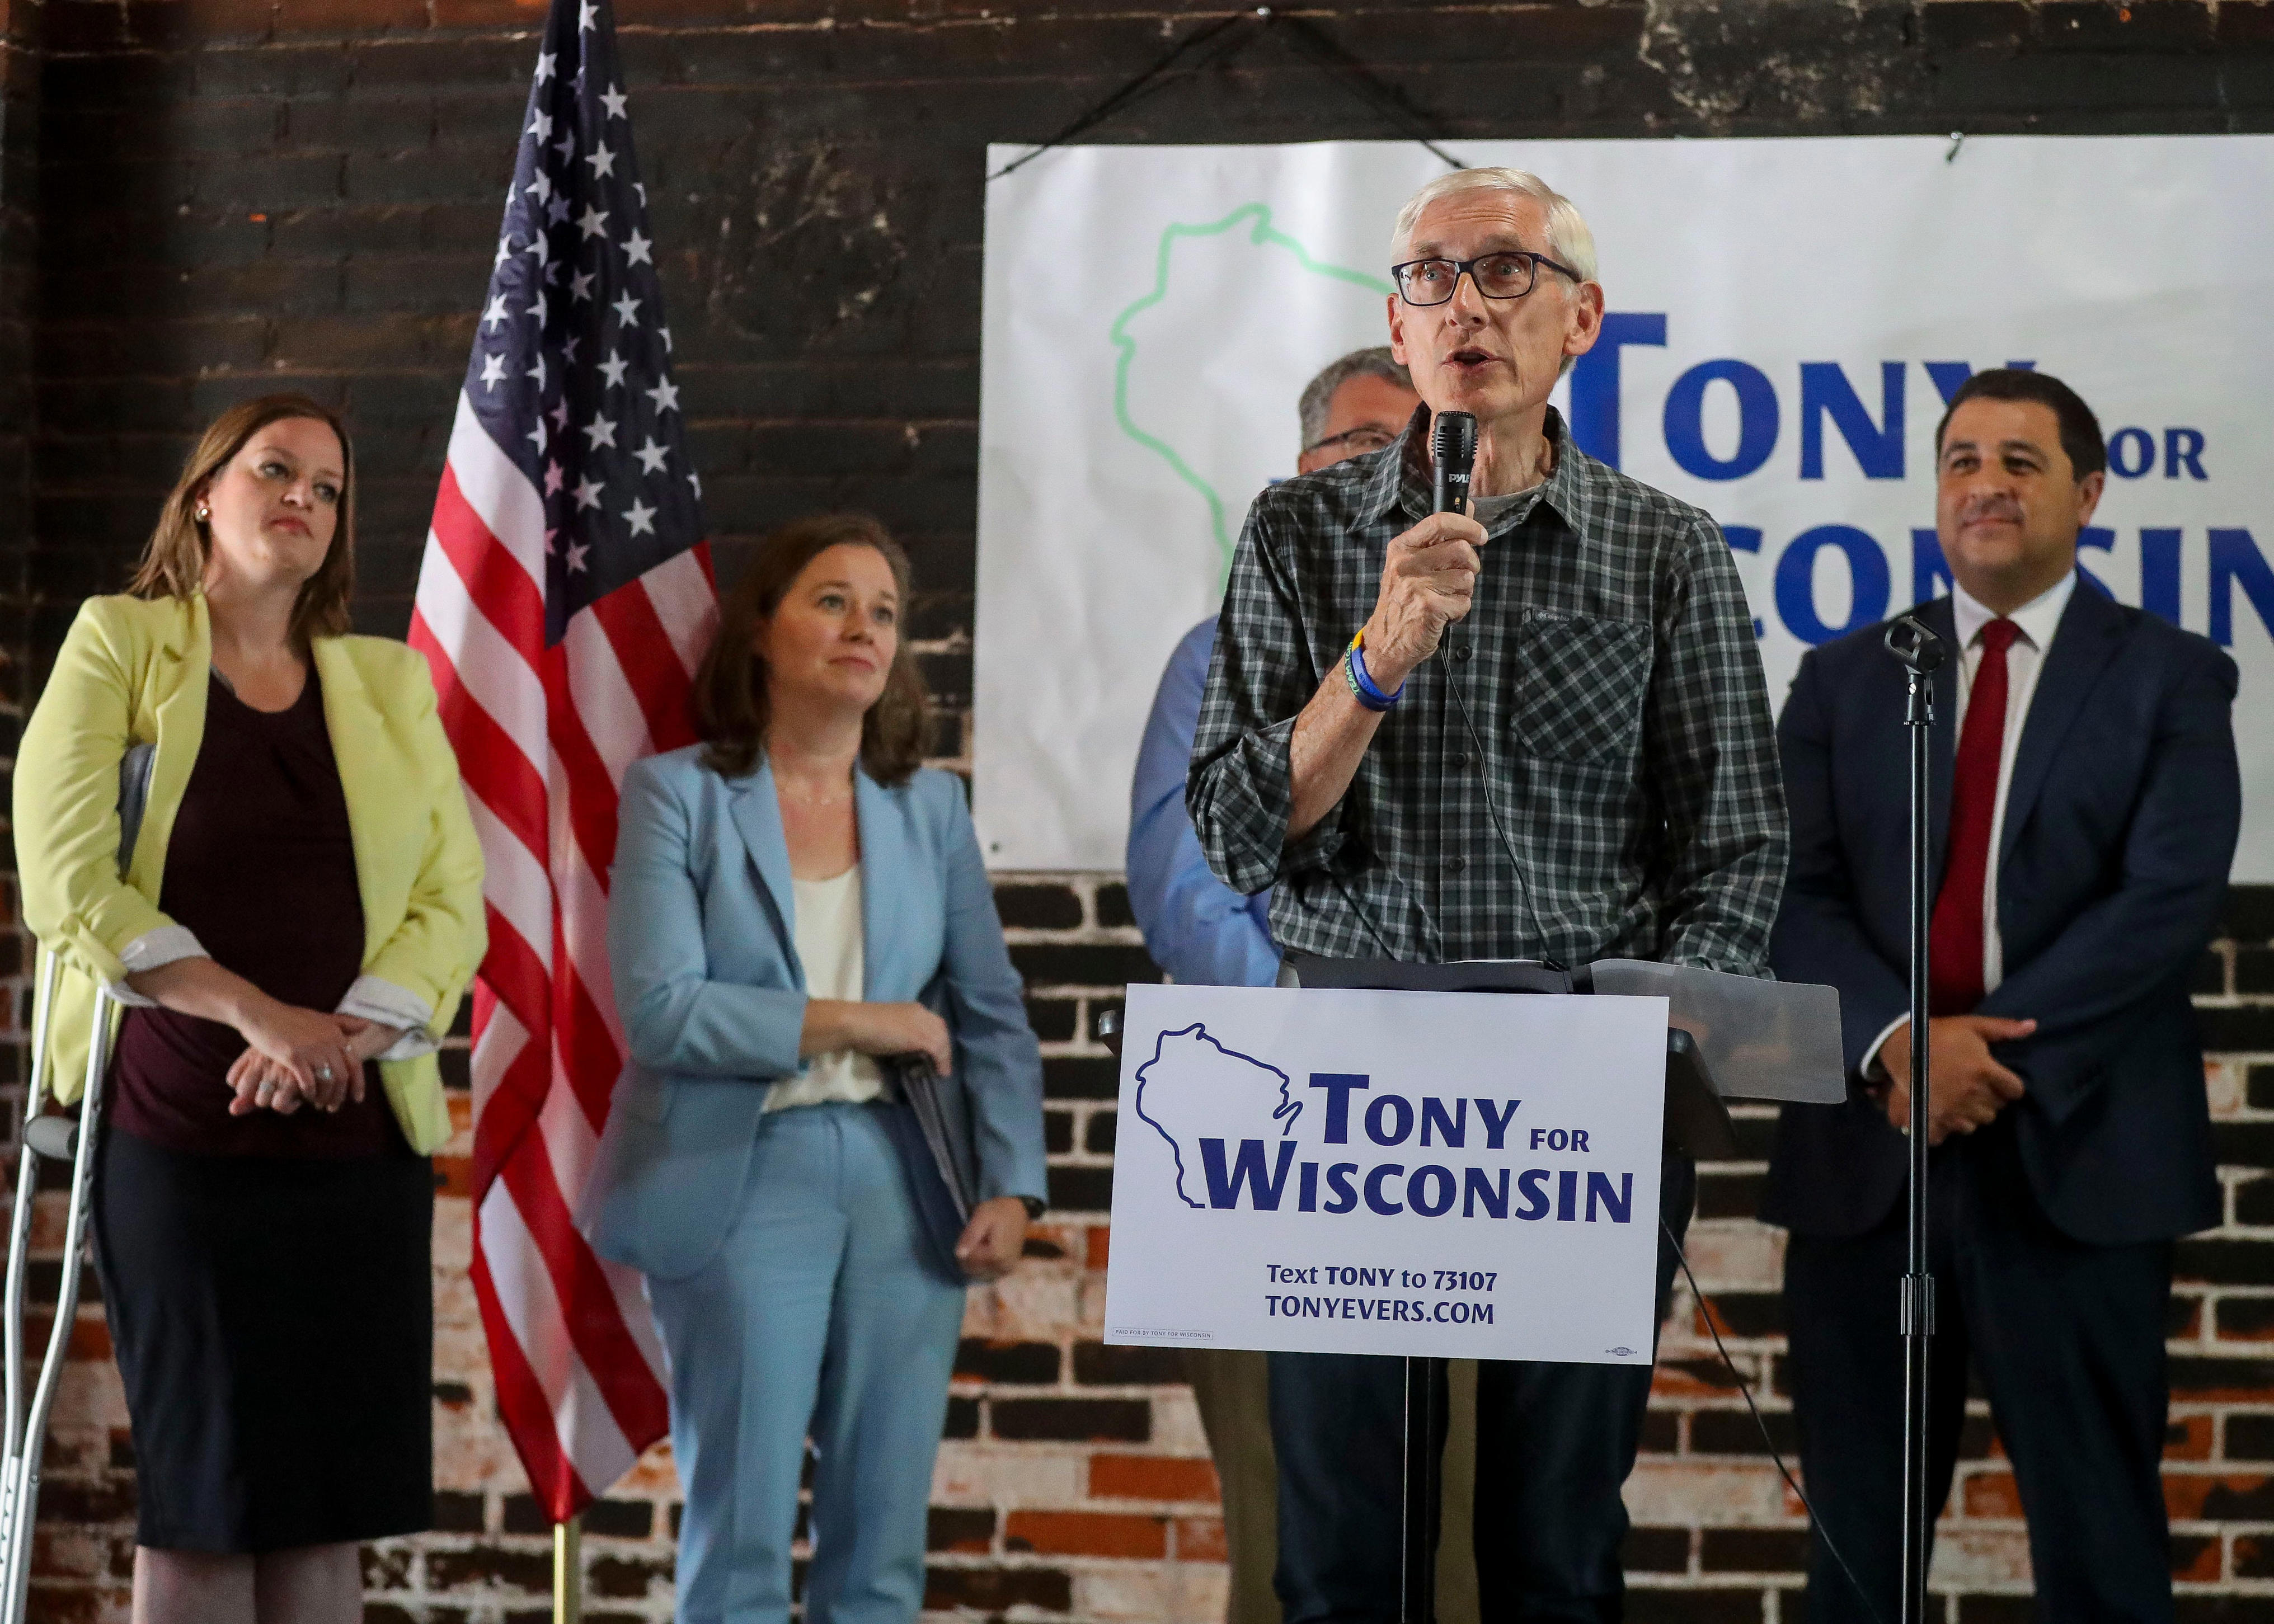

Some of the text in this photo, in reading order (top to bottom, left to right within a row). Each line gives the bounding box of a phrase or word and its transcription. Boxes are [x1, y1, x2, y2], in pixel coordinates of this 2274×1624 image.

[1568, 312, 2209, 482] TON OR
[1308, 1072, 1590, 1152] TONY FOR
[1198, 1137, 1634, 1223] WISCONSIN
[1265, 1295, 1493, 1325] TONYEVERS.COM
[1266, 1264, 1497, 1292] Text TONY to 73107
